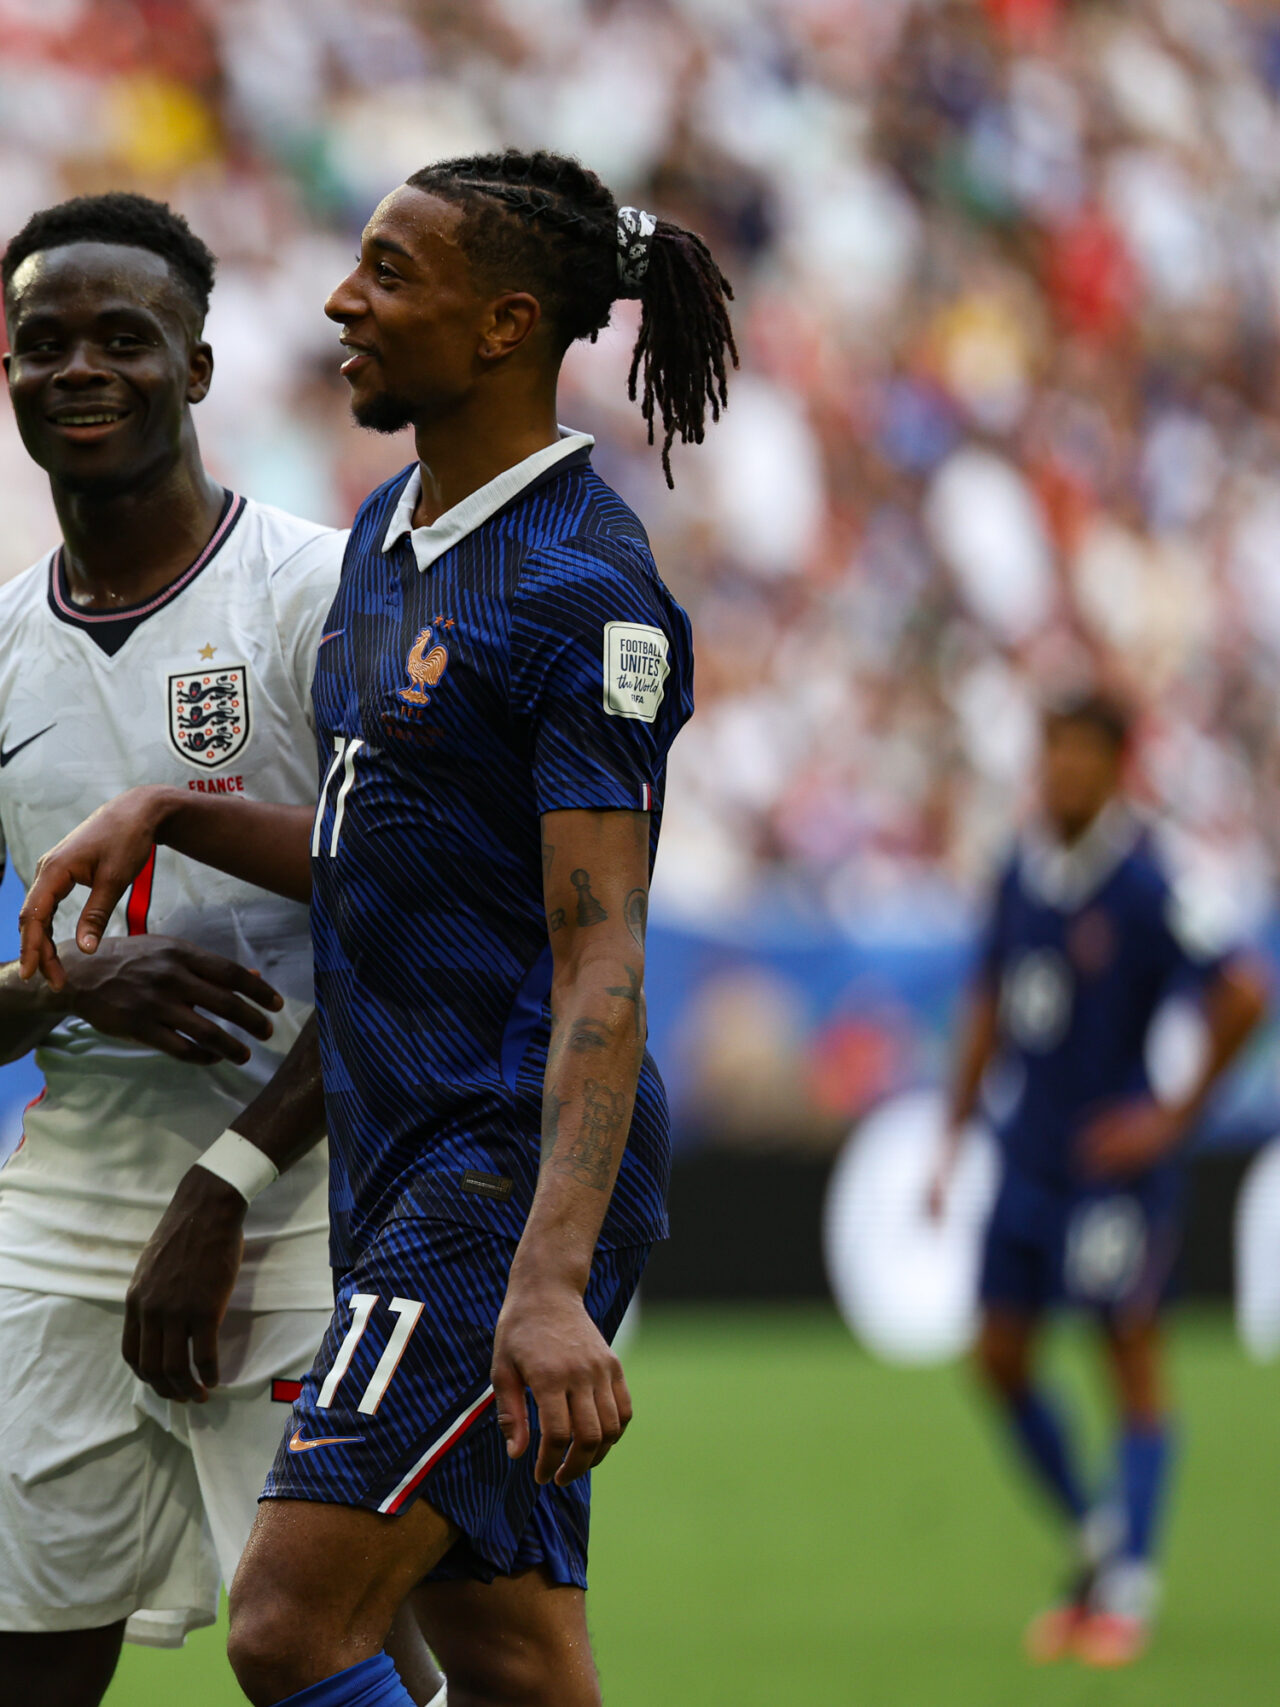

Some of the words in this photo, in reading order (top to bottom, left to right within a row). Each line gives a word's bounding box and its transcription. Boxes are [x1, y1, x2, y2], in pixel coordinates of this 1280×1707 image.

[620, 639, 662, 658] FOOTBALL
[621, 653, 660, 677] UNITES
[616, 674, 633, 689] the
[634, 676, 659, 695] World
[631, 694, 644, 703] FIFA
[188, 775, 244, 793] FRANCE
[312, 736, 364, 857] 11
[317, 1293, 426, 1415] 11
